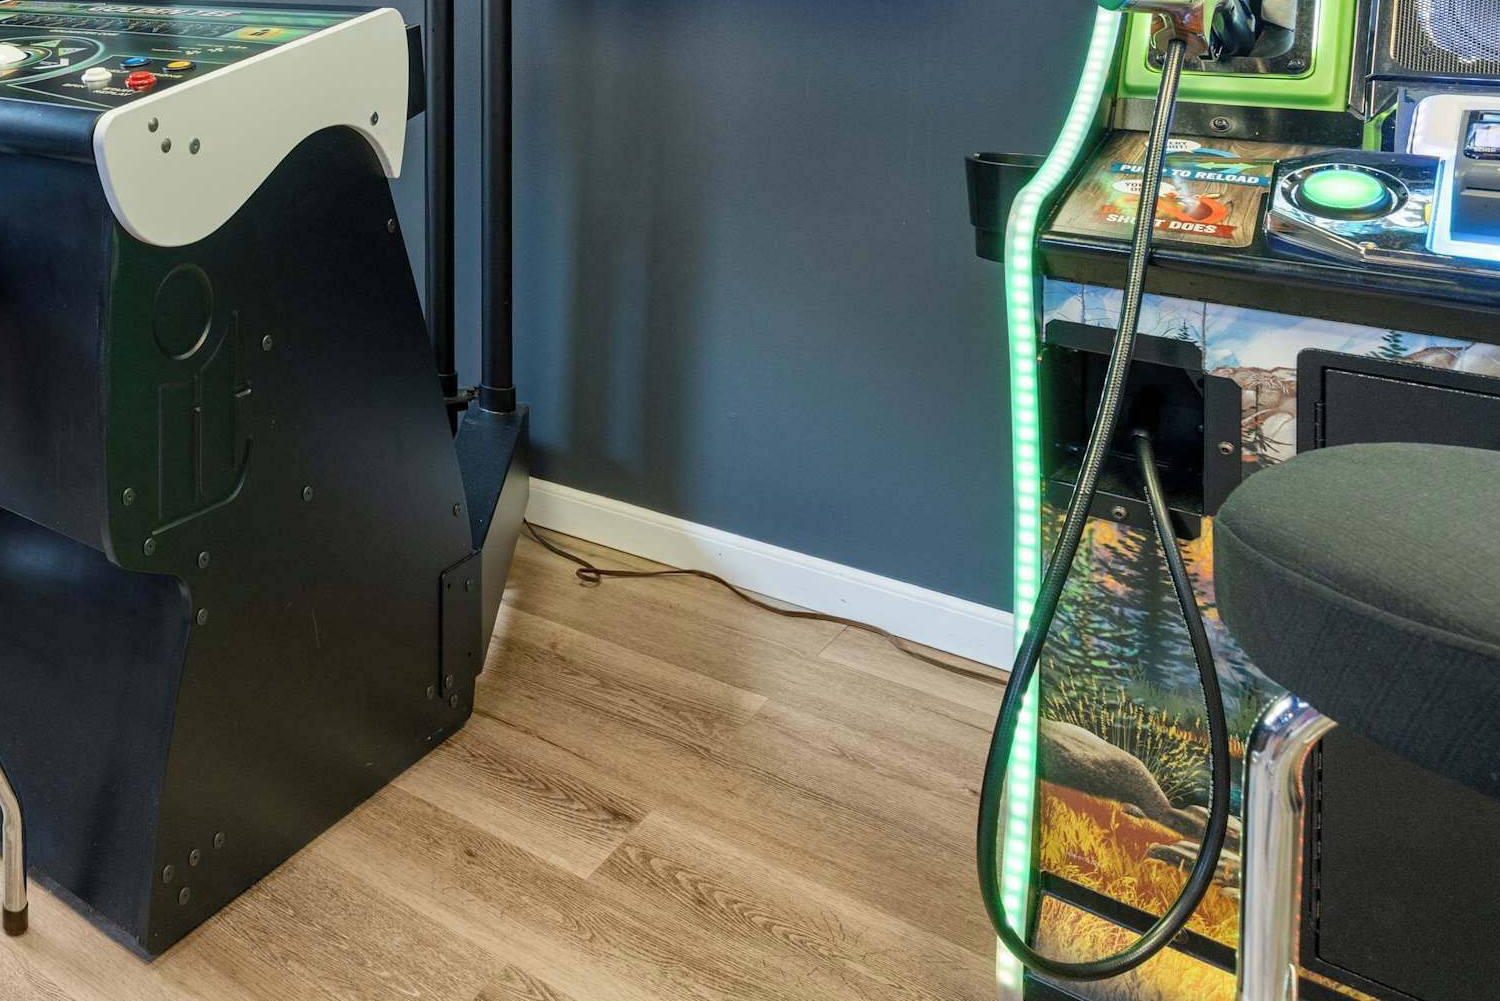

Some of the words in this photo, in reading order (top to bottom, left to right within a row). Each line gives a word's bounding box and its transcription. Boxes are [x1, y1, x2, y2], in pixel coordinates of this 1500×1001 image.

[1120, 164, 1167, 175] PU
[1172, 169, 1191, 178] TO
[1195, 172, 1259, 184] RELOAD
[1106, 214, 1164, 230] SHT
[1168, 222, 1217, 234] DOES
